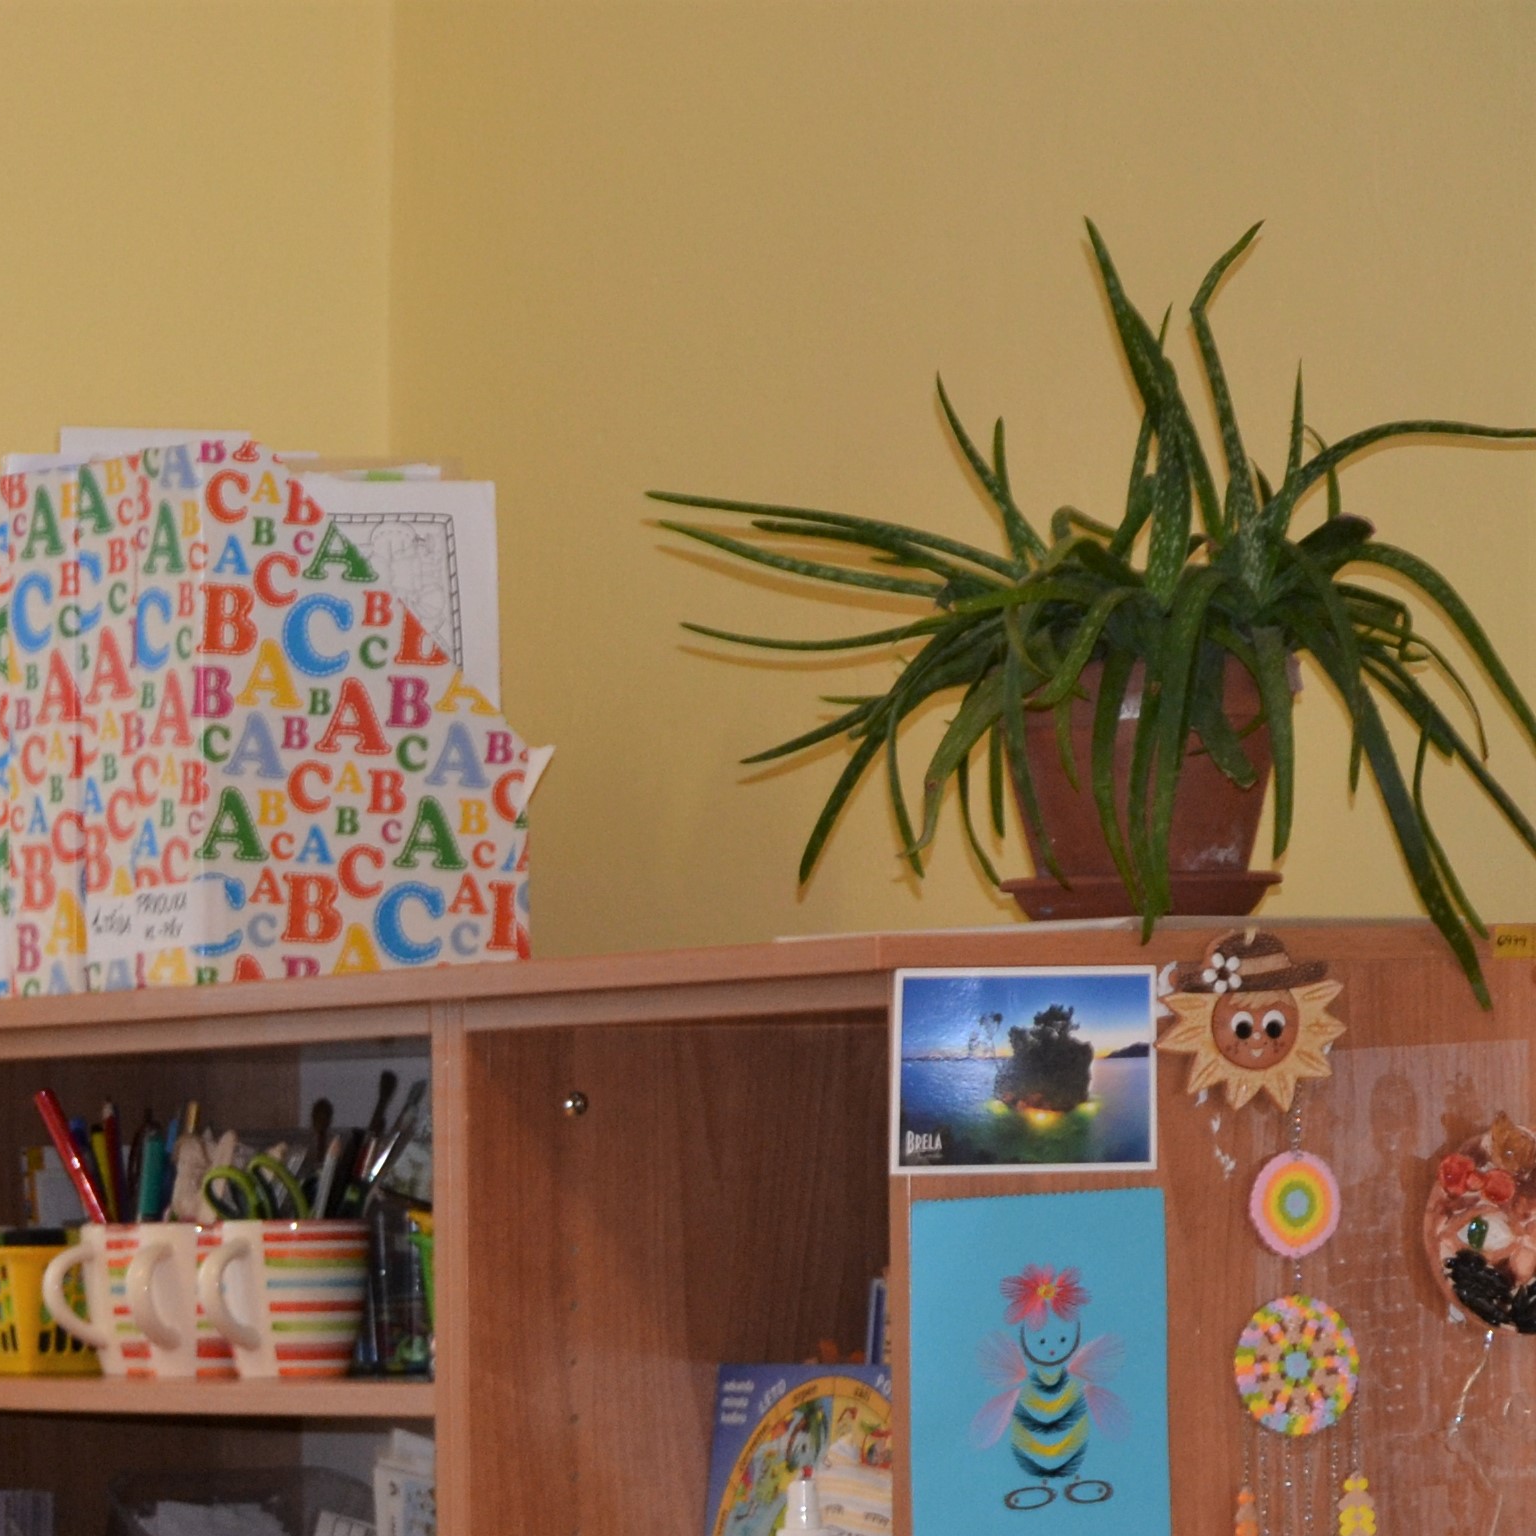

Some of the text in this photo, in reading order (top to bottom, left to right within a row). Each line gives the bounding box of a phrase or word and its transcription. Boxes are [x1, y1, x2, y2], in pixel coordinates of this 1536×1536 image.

[160, 444, 202, 489] A
[252, 472, 281, 505] A
[78, 465, 113, 534] A
[117, 499, 132, 526] C
[182, 501, 201, 538] B
[205, 469, 250, 524] C
[21, 484, 65, 559] A
[143, 500, 185, 574] A
[252, 517, 275, 546] B
[293, 531, 314, 556] C
[108, 538, 128, 574] B
[189, 543, 208, 571] C
[213, 535, 250, 576] A
[303, 521, 378, 582] A
[109, 583, 125, 614] C
[178, 582, 195, 617] B
[253, 552, 300, 608] C
[11, 571, 53, 651] C
[137, 586, 171, 670] C
[197, 582, 258, 655] B
[362, 591, 393, 628] B
[177, 628, 189, 659] C
[282, 593, 353, 678] C
[359, 636, 388, 669] C
[87, 627, 133, 703] A
[236, 639, 303, 709] A
[150, 669, 194, 746] A
[191, 665, 234, 718] B
[309, 687, 331, 715] B
[386, 675, 431, 728] B
[281, 716, 310, 750] B
[315, 677, 392, 755] A
[22, 736, 47, 785] C
[200, 723, 231, 762] C
[223, 711, 288, 778] A
[396, 734, 428, 772] C
[426, 721, 490, 788] A
[484, 731, 514, 765] B
[132, 755, 159, 807] C
[287, 760, 334, 814] C
[334, 761, 365, 795] A
[368, 767, 407, 815] B
[492, 769, 527, 822] C
[29, 796, 48, 834] A
[107, 788, 136, 840] C
[195, 786, 269, 862] A
[257, 789, 287, 827] B
[336, 806, 360, 836] B
[381, 819, 403, 844] C
[458, 798, 488, 836] B
[52, 810, 84, 863] C
[270, 832, 295, 861] C
[296, 824, 334, 866] A
[394, 795, 468, 870] A
[472, 841, 496, 869] C
[20, 843, 57, 911] B
[161, 836, 190, 884] C
[338, 844, 385, 898] C
[248, 866, 284, 906] A
[281, 872, 343, 943] B
[447, 873, 489, 916] A
[247, 912, 277, 948] C
[373, 880, 445, 965] C
[450, 920, 481, 956] C
[17, 922, 41, 974] B
[333, 921, 383, 977] A
[905, 1129, 943, 1156] BRELA
